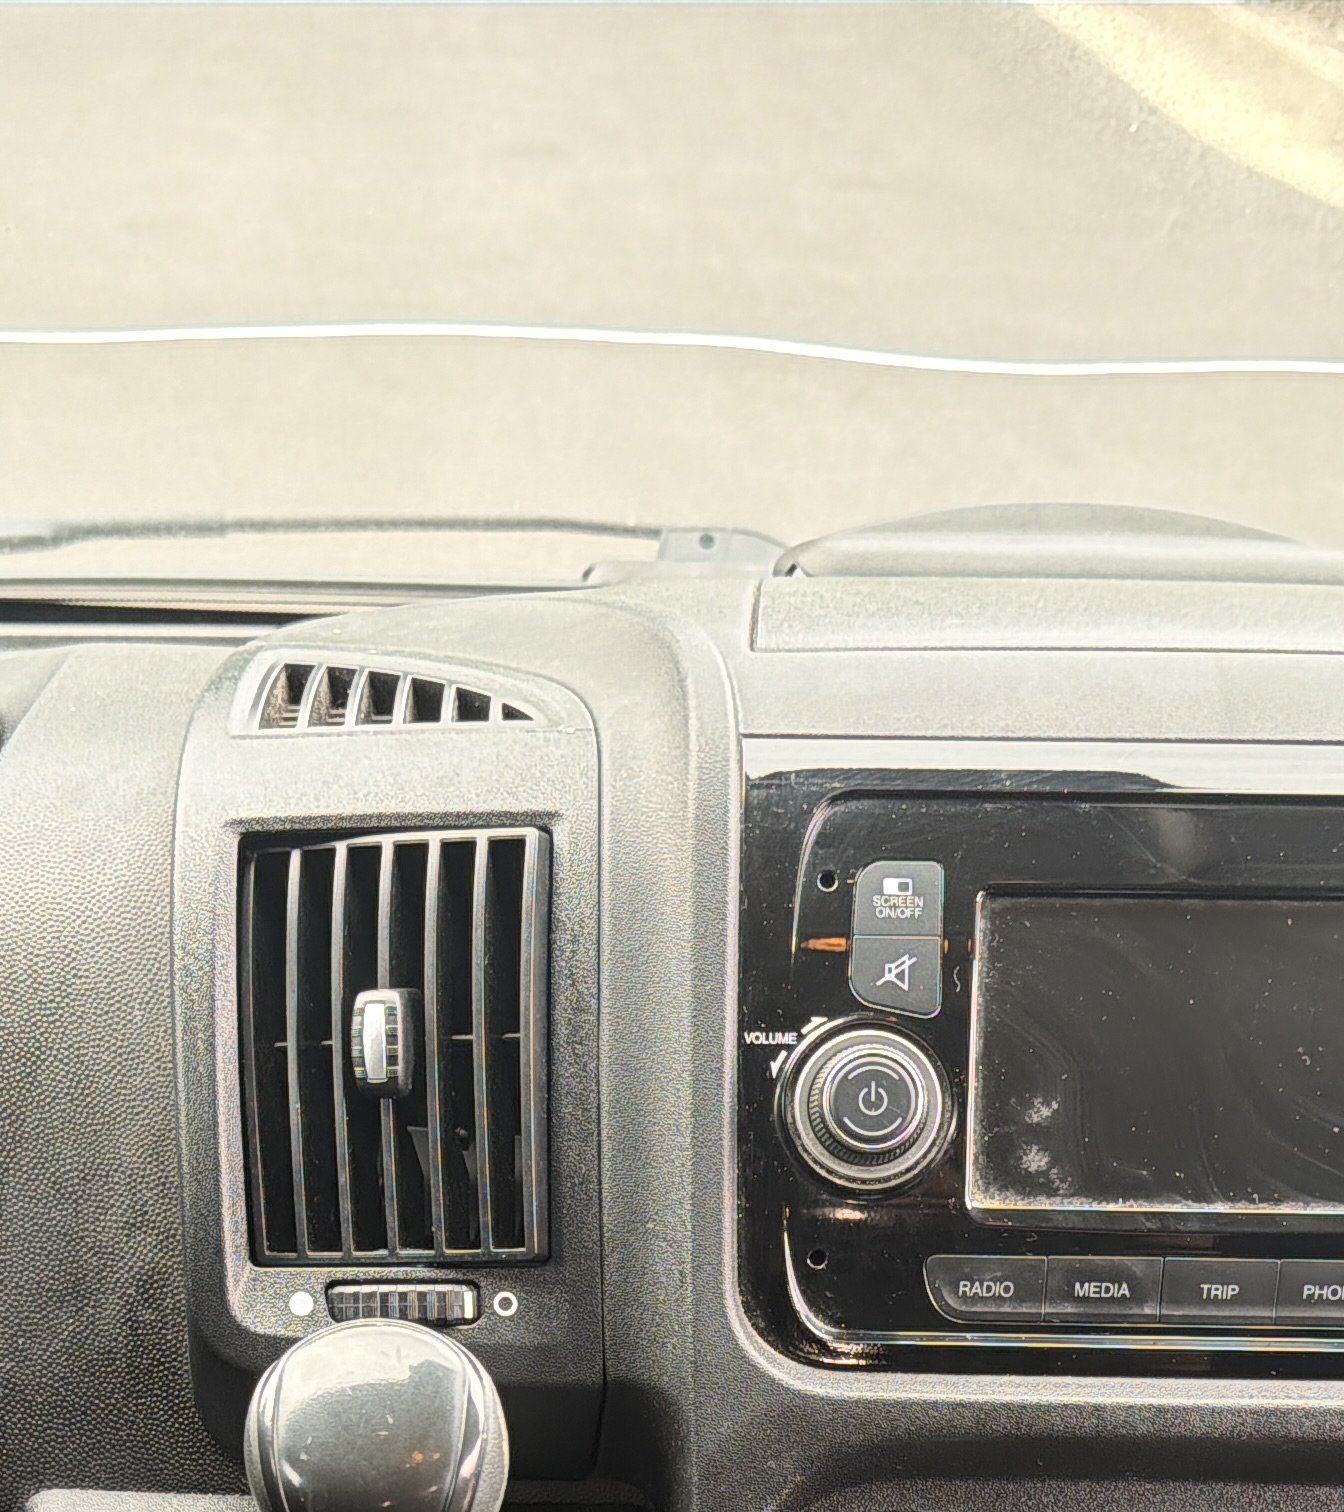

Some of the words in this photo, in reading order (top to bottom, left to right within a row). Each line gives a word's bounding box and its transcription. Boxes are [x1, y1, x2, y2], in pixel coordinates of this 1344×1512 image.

[872, 896, 924, 909] SCREEN
[875, 907, 923, 920] ON/OFF
[744, 1032, 798, 1046] VOLUME
[958, 1280, 1015, 1299] RADIO
[1074, 1281, 1131, 1300] MEDIA
[1200, 1283, 1240, 1300] TRIP
